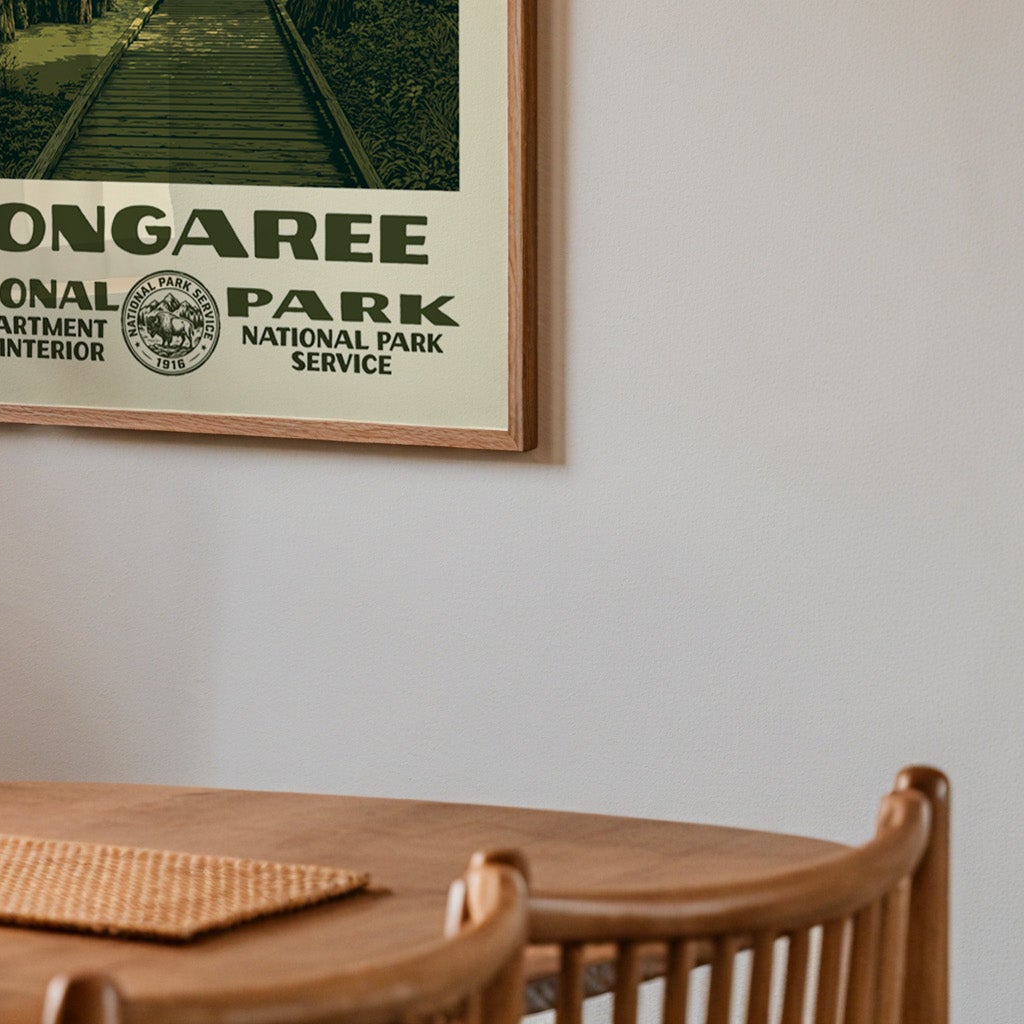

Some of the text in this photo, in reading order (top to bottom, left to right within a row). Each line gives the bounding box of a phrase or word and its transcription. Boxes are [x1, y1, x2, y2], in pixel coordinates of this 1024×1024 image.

[126, 276, 215, 341] NATIONAL PARK SERVICE
[226, 287, 460, 327] PARK
[0, 337, 105, 362] INTERIOR
[242, 325, 444, 354] NATIONAL PARK
[156, 357, 186, 370] 1916
[291, 350, 392, 375] SERVICE
